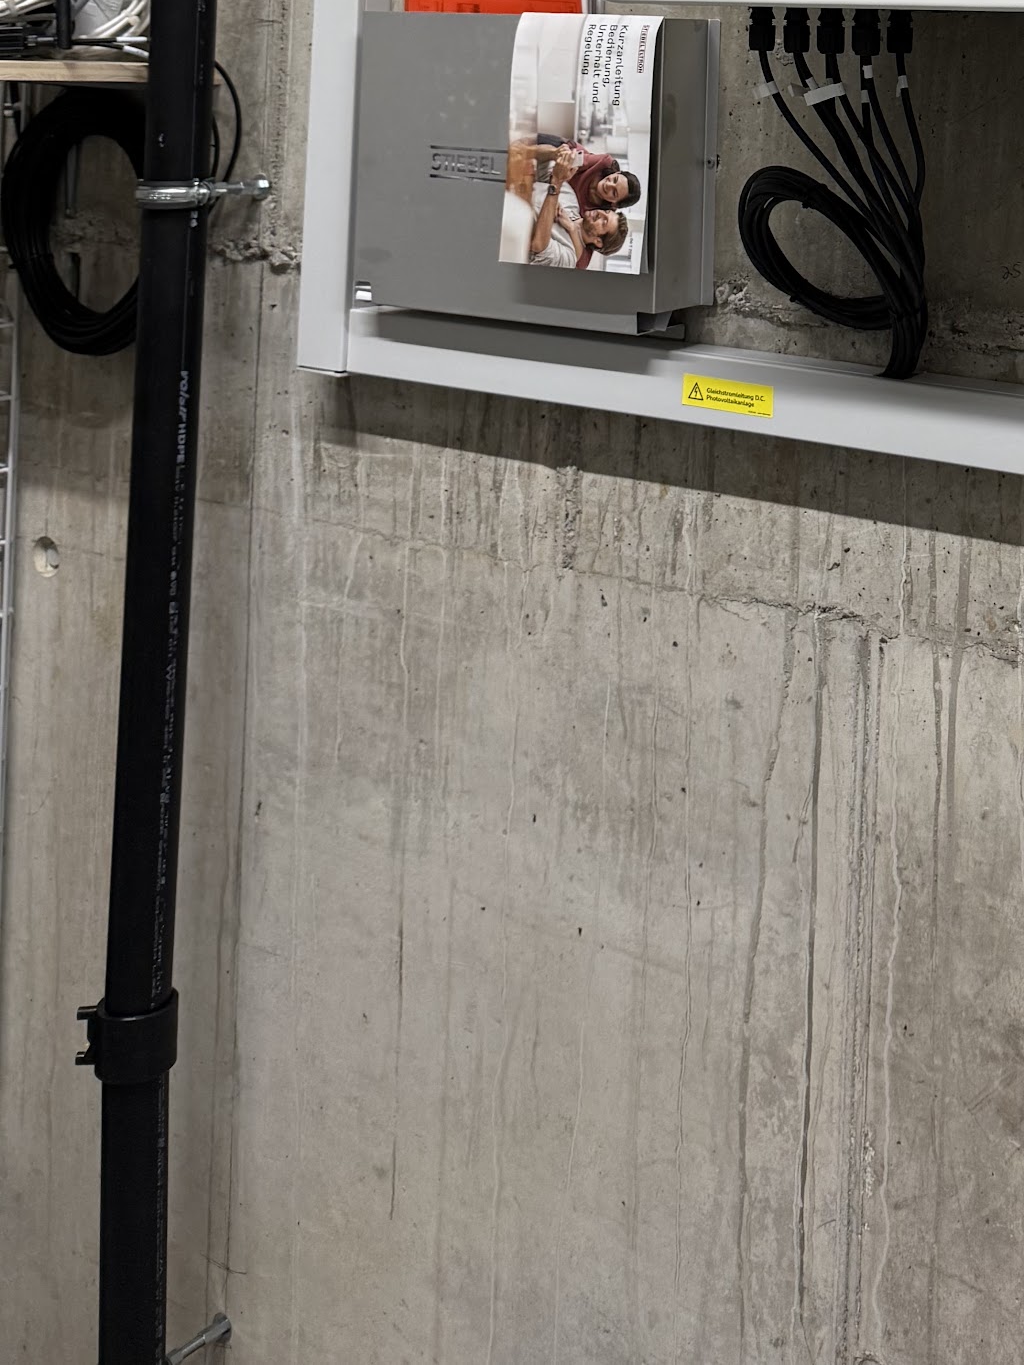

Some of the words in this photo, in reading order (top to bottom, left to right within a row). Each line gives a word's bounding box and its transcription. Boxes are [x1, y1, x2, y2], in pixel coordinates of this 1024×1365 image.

[581, 23, 596, 76] Regelung
[592, 24, 607, 78] Unterhalt
[638, 24, 650, 48] STIEBEL
[602, 24, 618, 88] Bedienung,
[612, 24, 629, 107] Kurzanleitung
[591, 82, 601, 104] und
[430, 152, 502, 176] STIEBEL
[706, 387, 754, 401] Gleichstromleitung
[706, 395, 755, 408] Photovoltaikanlage
[176, 423, 187, 464] HDPE
